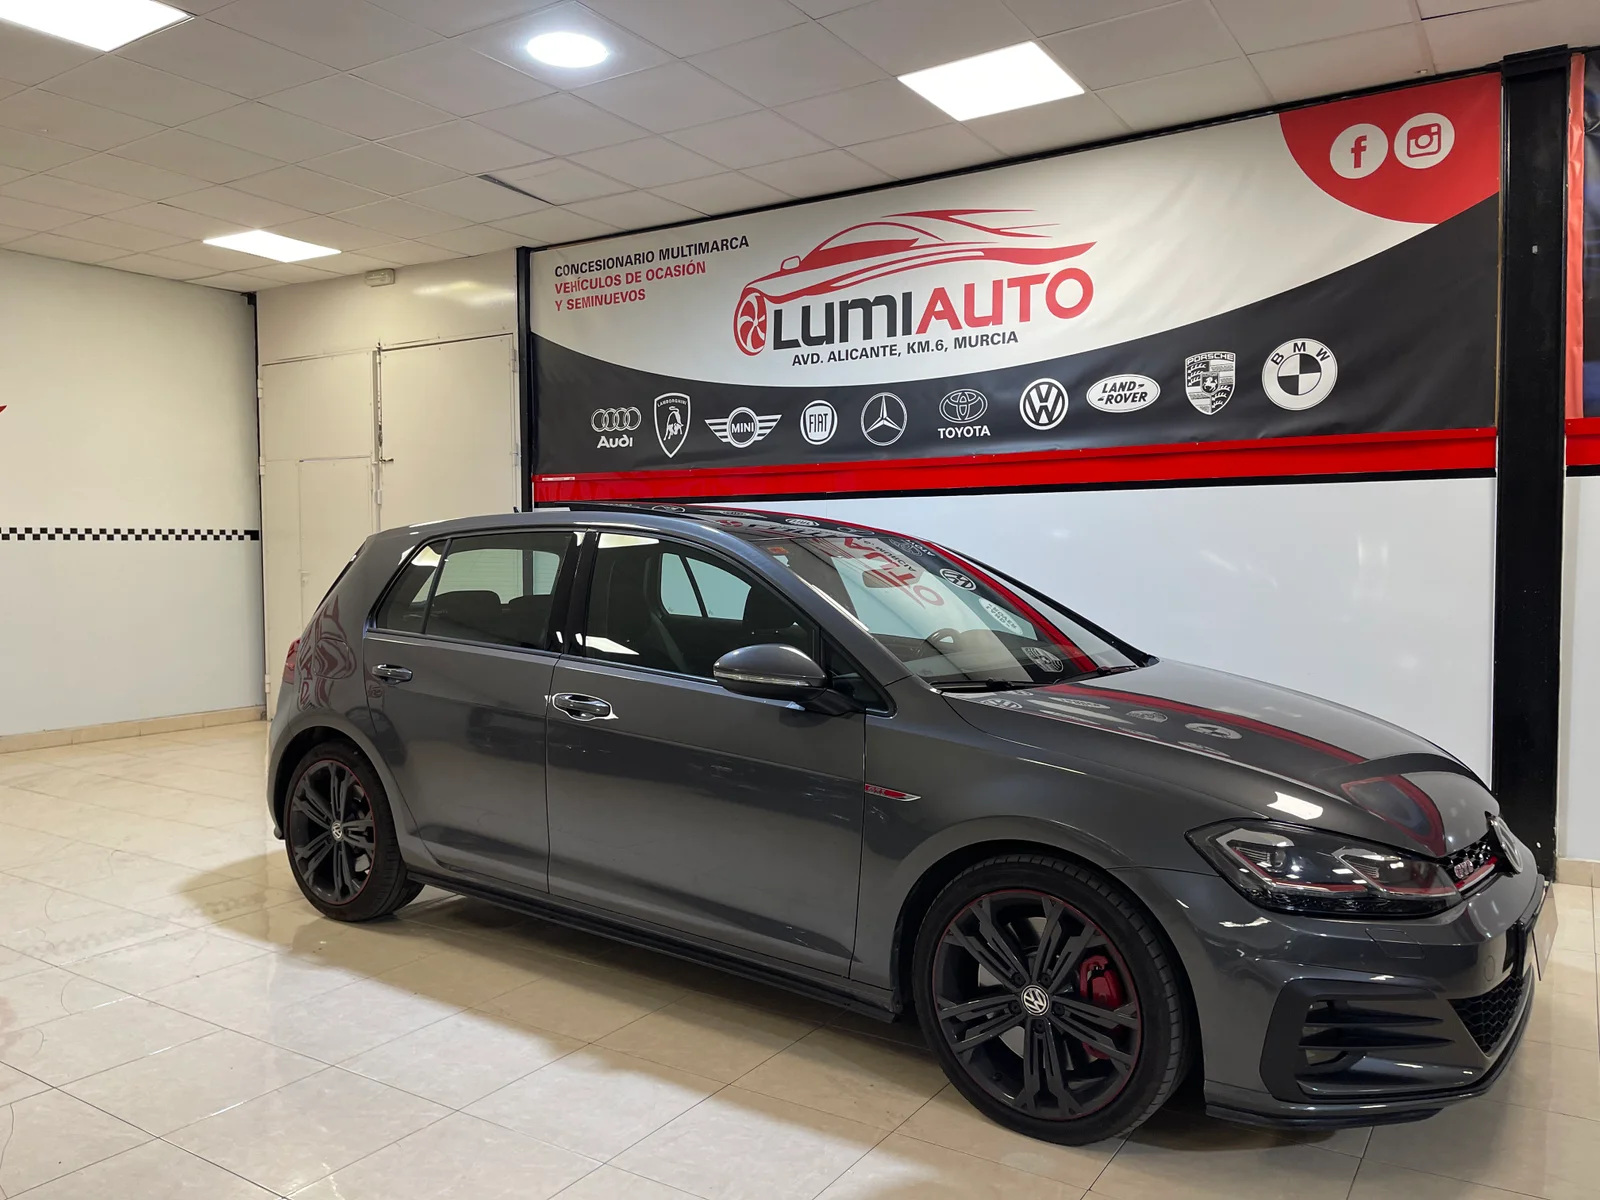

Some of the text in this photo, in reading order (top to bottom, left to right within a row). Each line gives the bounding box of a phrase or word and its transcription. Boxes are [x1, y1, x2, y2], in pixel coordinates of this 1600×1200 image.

[554, 235, 749, 278] CONCESIONARIO MULTIMARCA
[554, 260, 706, 295] VEHÍCULOS DE OCASIÓN
[554, 288, 646, 312] Y SEMINUEVOS
[792, 330, 1019, 367] AVD. ALICANTE, KM.6, MURCIA
[1187, 353, 1235, 366] PORSCHE
[731, 421, 755, 434] MINI
[809, 412, 829, 435] FIAT
[937, 424, 991, 440] TOYOTA
[596, 434, 634, 449] Audi
